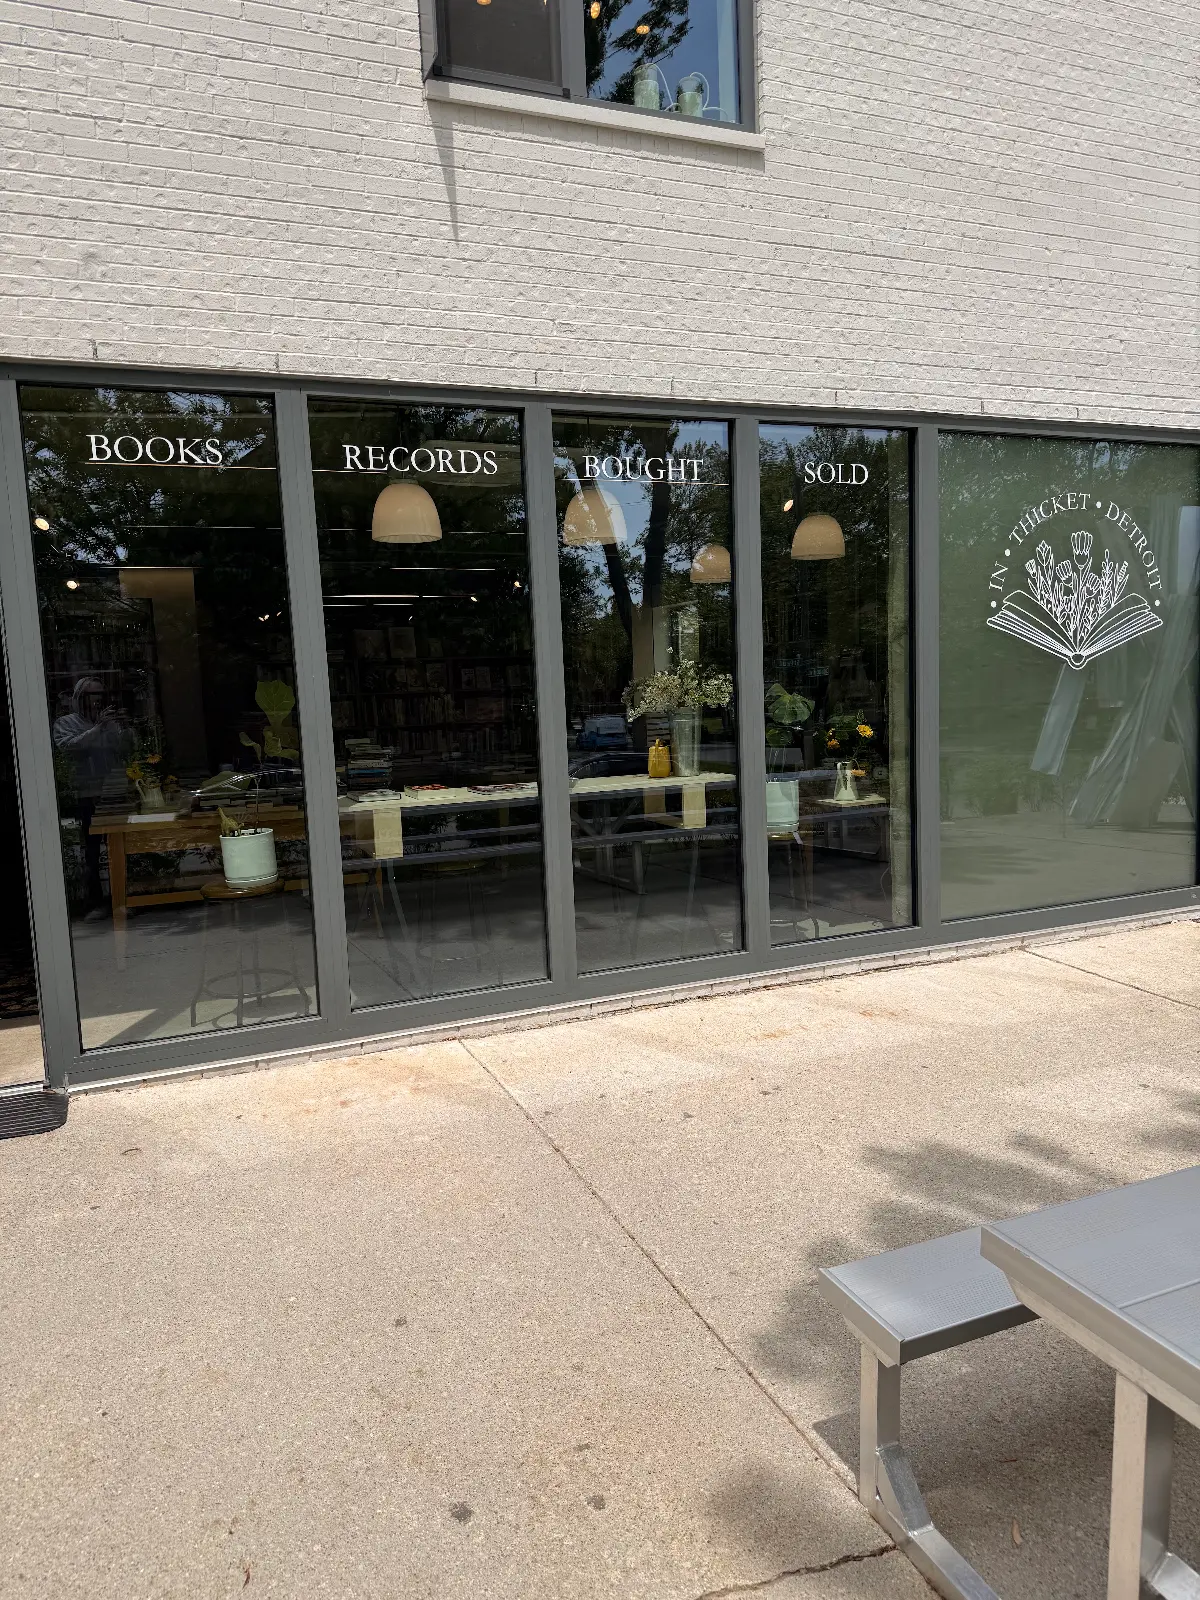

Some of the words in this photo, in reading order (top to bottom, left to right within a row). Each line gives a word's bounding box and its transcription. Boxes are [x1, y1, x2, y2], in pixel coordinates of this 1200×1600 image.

[86, 434, 223, 465] BOOKS
[342, 444, 498, 475] RECORDS
[583, 455, 704, 481] BOUGHT
[804, 462, 869, 485] SOLD
[989, 561, 1009, 592] IN
[1009, 492, 1091, 546] THICKET
[1105, 501, 1163, 590] DETROIT
